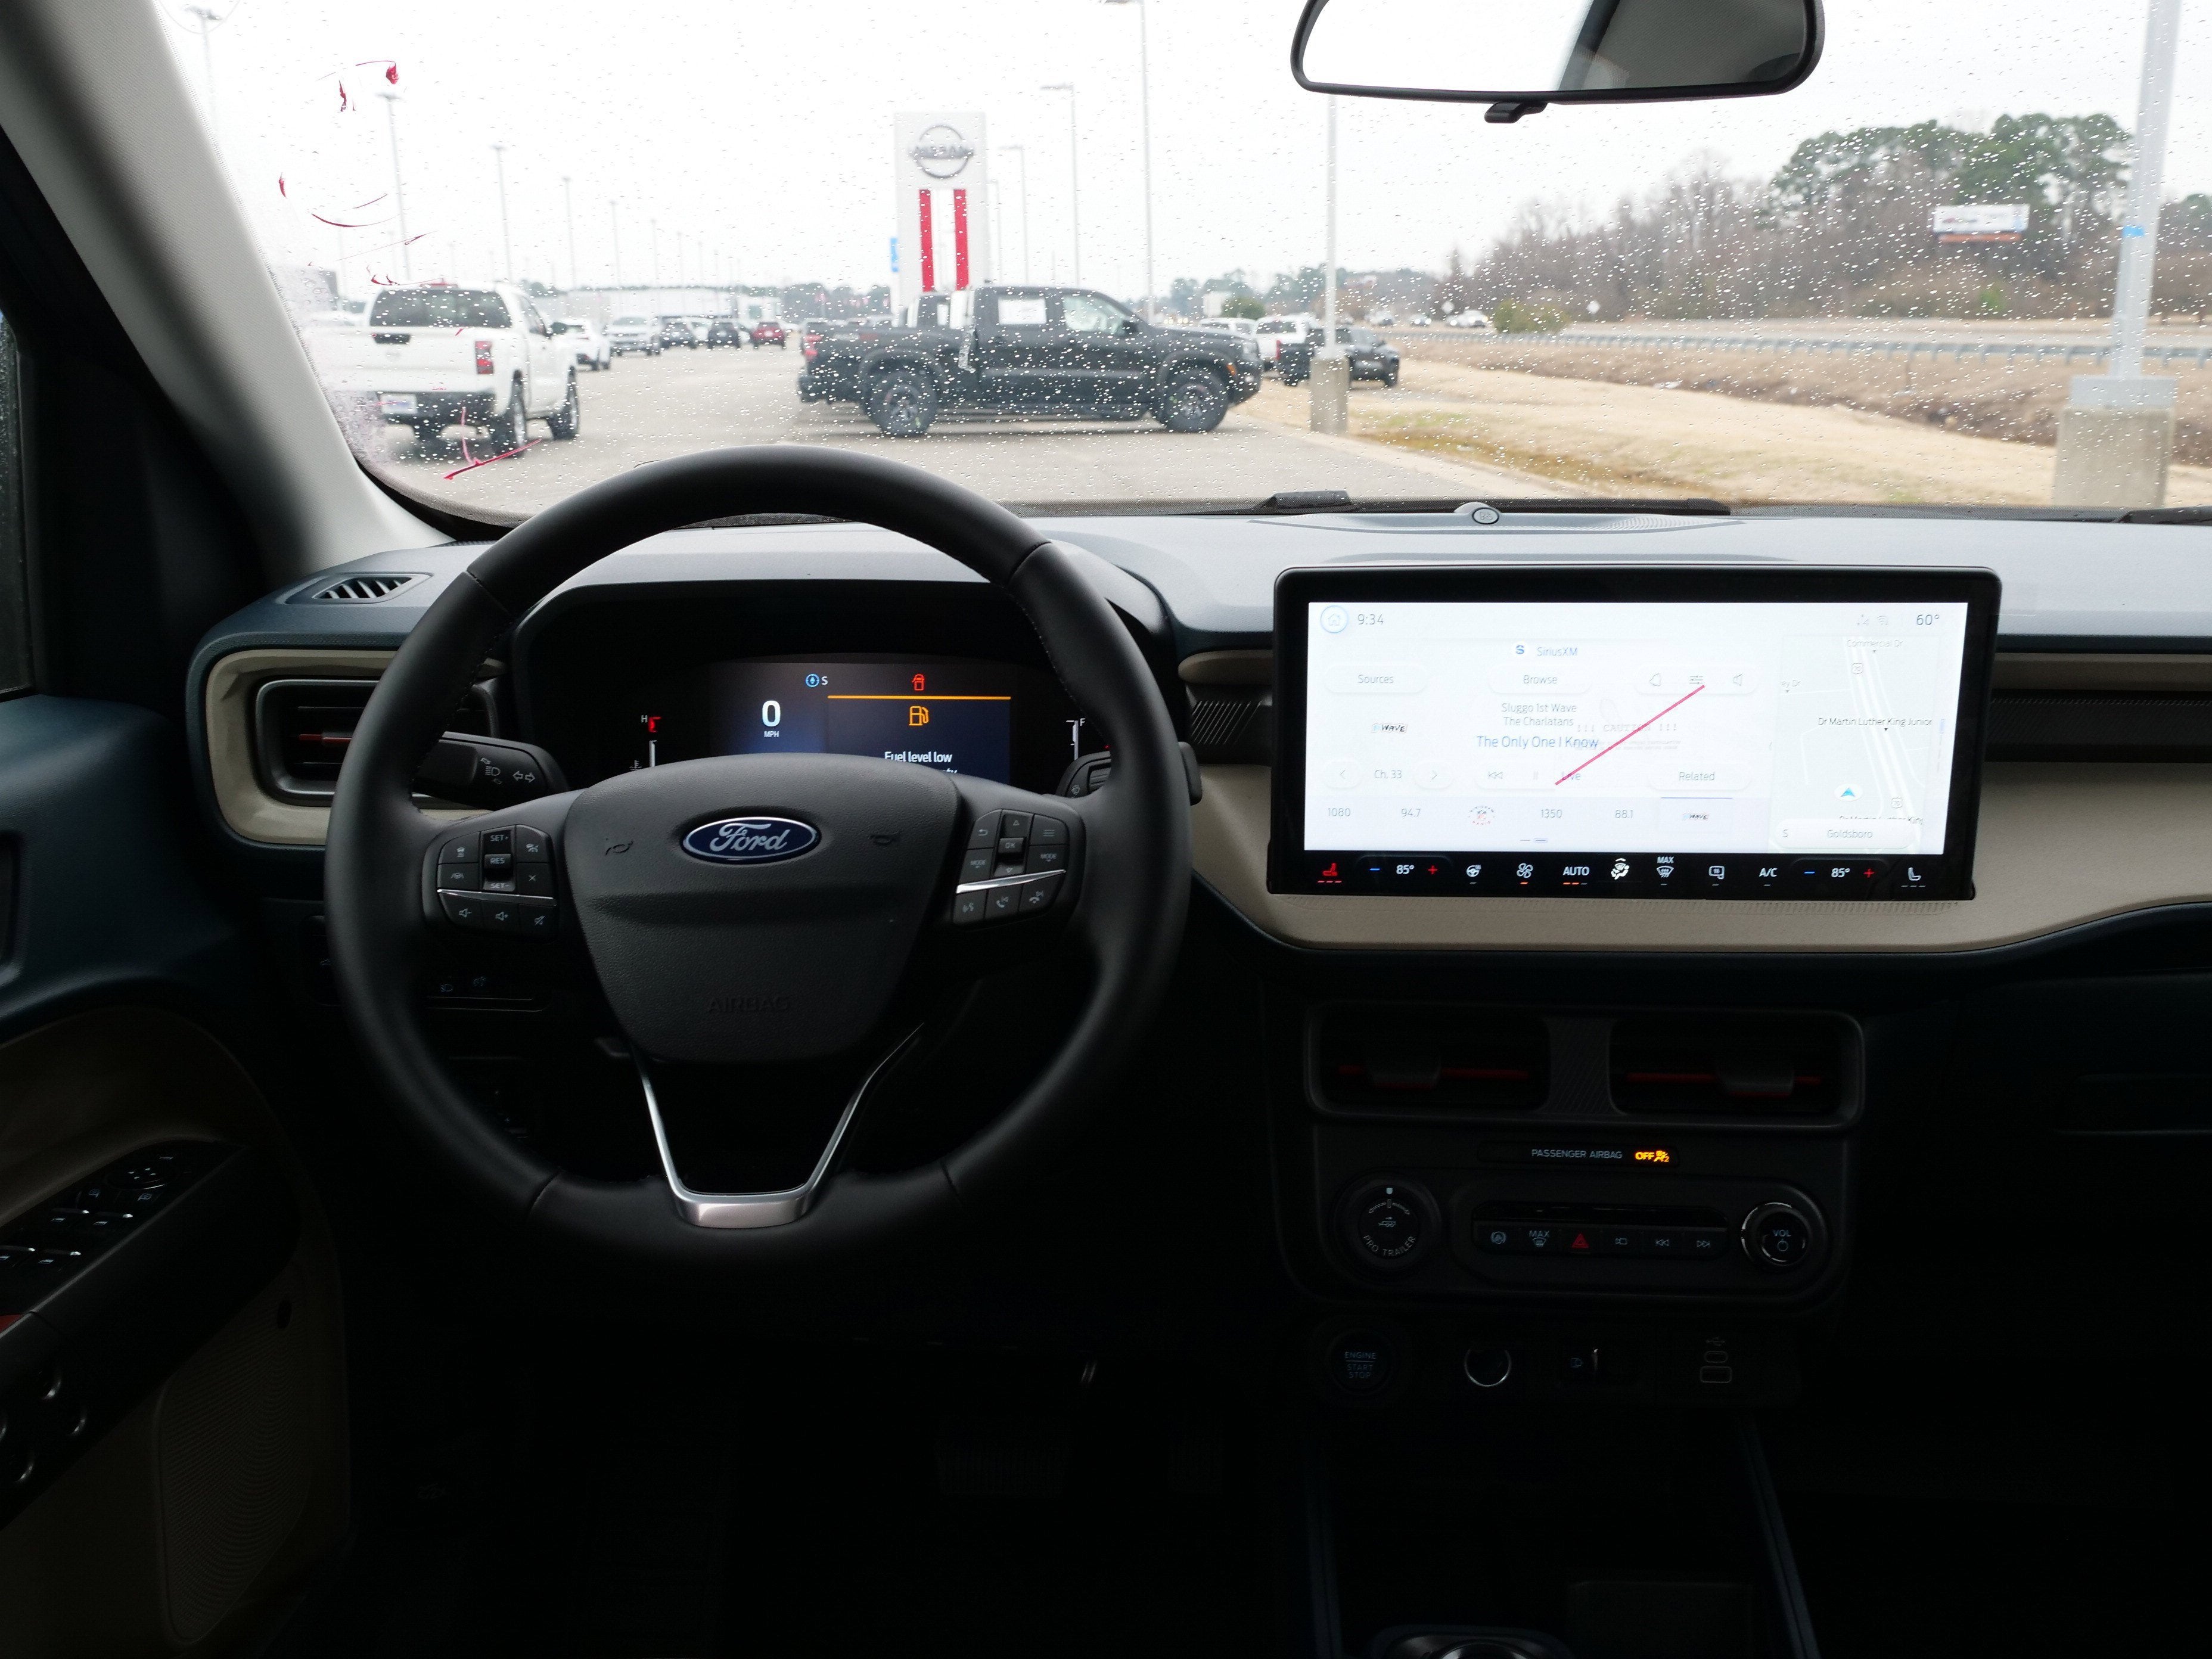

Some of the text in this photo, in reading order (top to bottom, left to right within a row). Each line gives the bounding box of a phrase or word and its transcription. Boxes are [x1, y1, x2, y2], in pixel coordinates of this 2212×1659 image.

[1357, 614, 1384, 626] 9:34
[1915, 614, 1940, 626] 60°
[1536, 647, 1578, 657] SiriusXM
[821, 676, 828, 685] S
[1357, 674, 1394, 684] Sources
[1523, 675, 1557, 685] Browse
[762, 700, 781, 727] 0
[1502, 703, 1577, 714] Sluggo 1st Wave
[641, 714, 648, 723] H
[1079, 718, 1086, 726] F
[1503, 717, 1574, 726] The Charlatans
[1888, 717, 1906, 728] King
[1603, 723, 1651, 732] CAUTIN
[1477, 736, 1498, 747] The
[1502, 736, 1528, 750] Only
[1532, 736, 1555, 747] One
[1565, 736, 1599, 748] Know
[884, 751, 953, 763] Fuel level low
[1374, 769, 1402, 779] Ch. 33
[1562, 771, 1581, 781] Lve
[1678, 771, 1715, 781] Related
[1328, 807, 1351, 817] 1080
[1401, 808, 1421, 818] 94.7
[1540, 809, 1562, 818] 1350
[1614, 809, 1633, 819] 88.1
[709, 822, 791, 852] Ford
[1827, 829, 1874, 838] Goldsboro
[1396, 864, 1415, 875] 85°
[1563, 866, 1589, 876] AUTO
[1759, 868, 1778, 878] A/C
[1831, 868, 1850, 878] 85°
[709, 996, 791, 1014] AIRBAG
[1531, 1149, 1623, 1160] PASSENGER AIRBAG
[1635, 1151, 1655, 1161] OFF
[1528, 1229, 1549, 1239] MAX
[1362, 1234, 1416, 1257] PRO TRAILER
